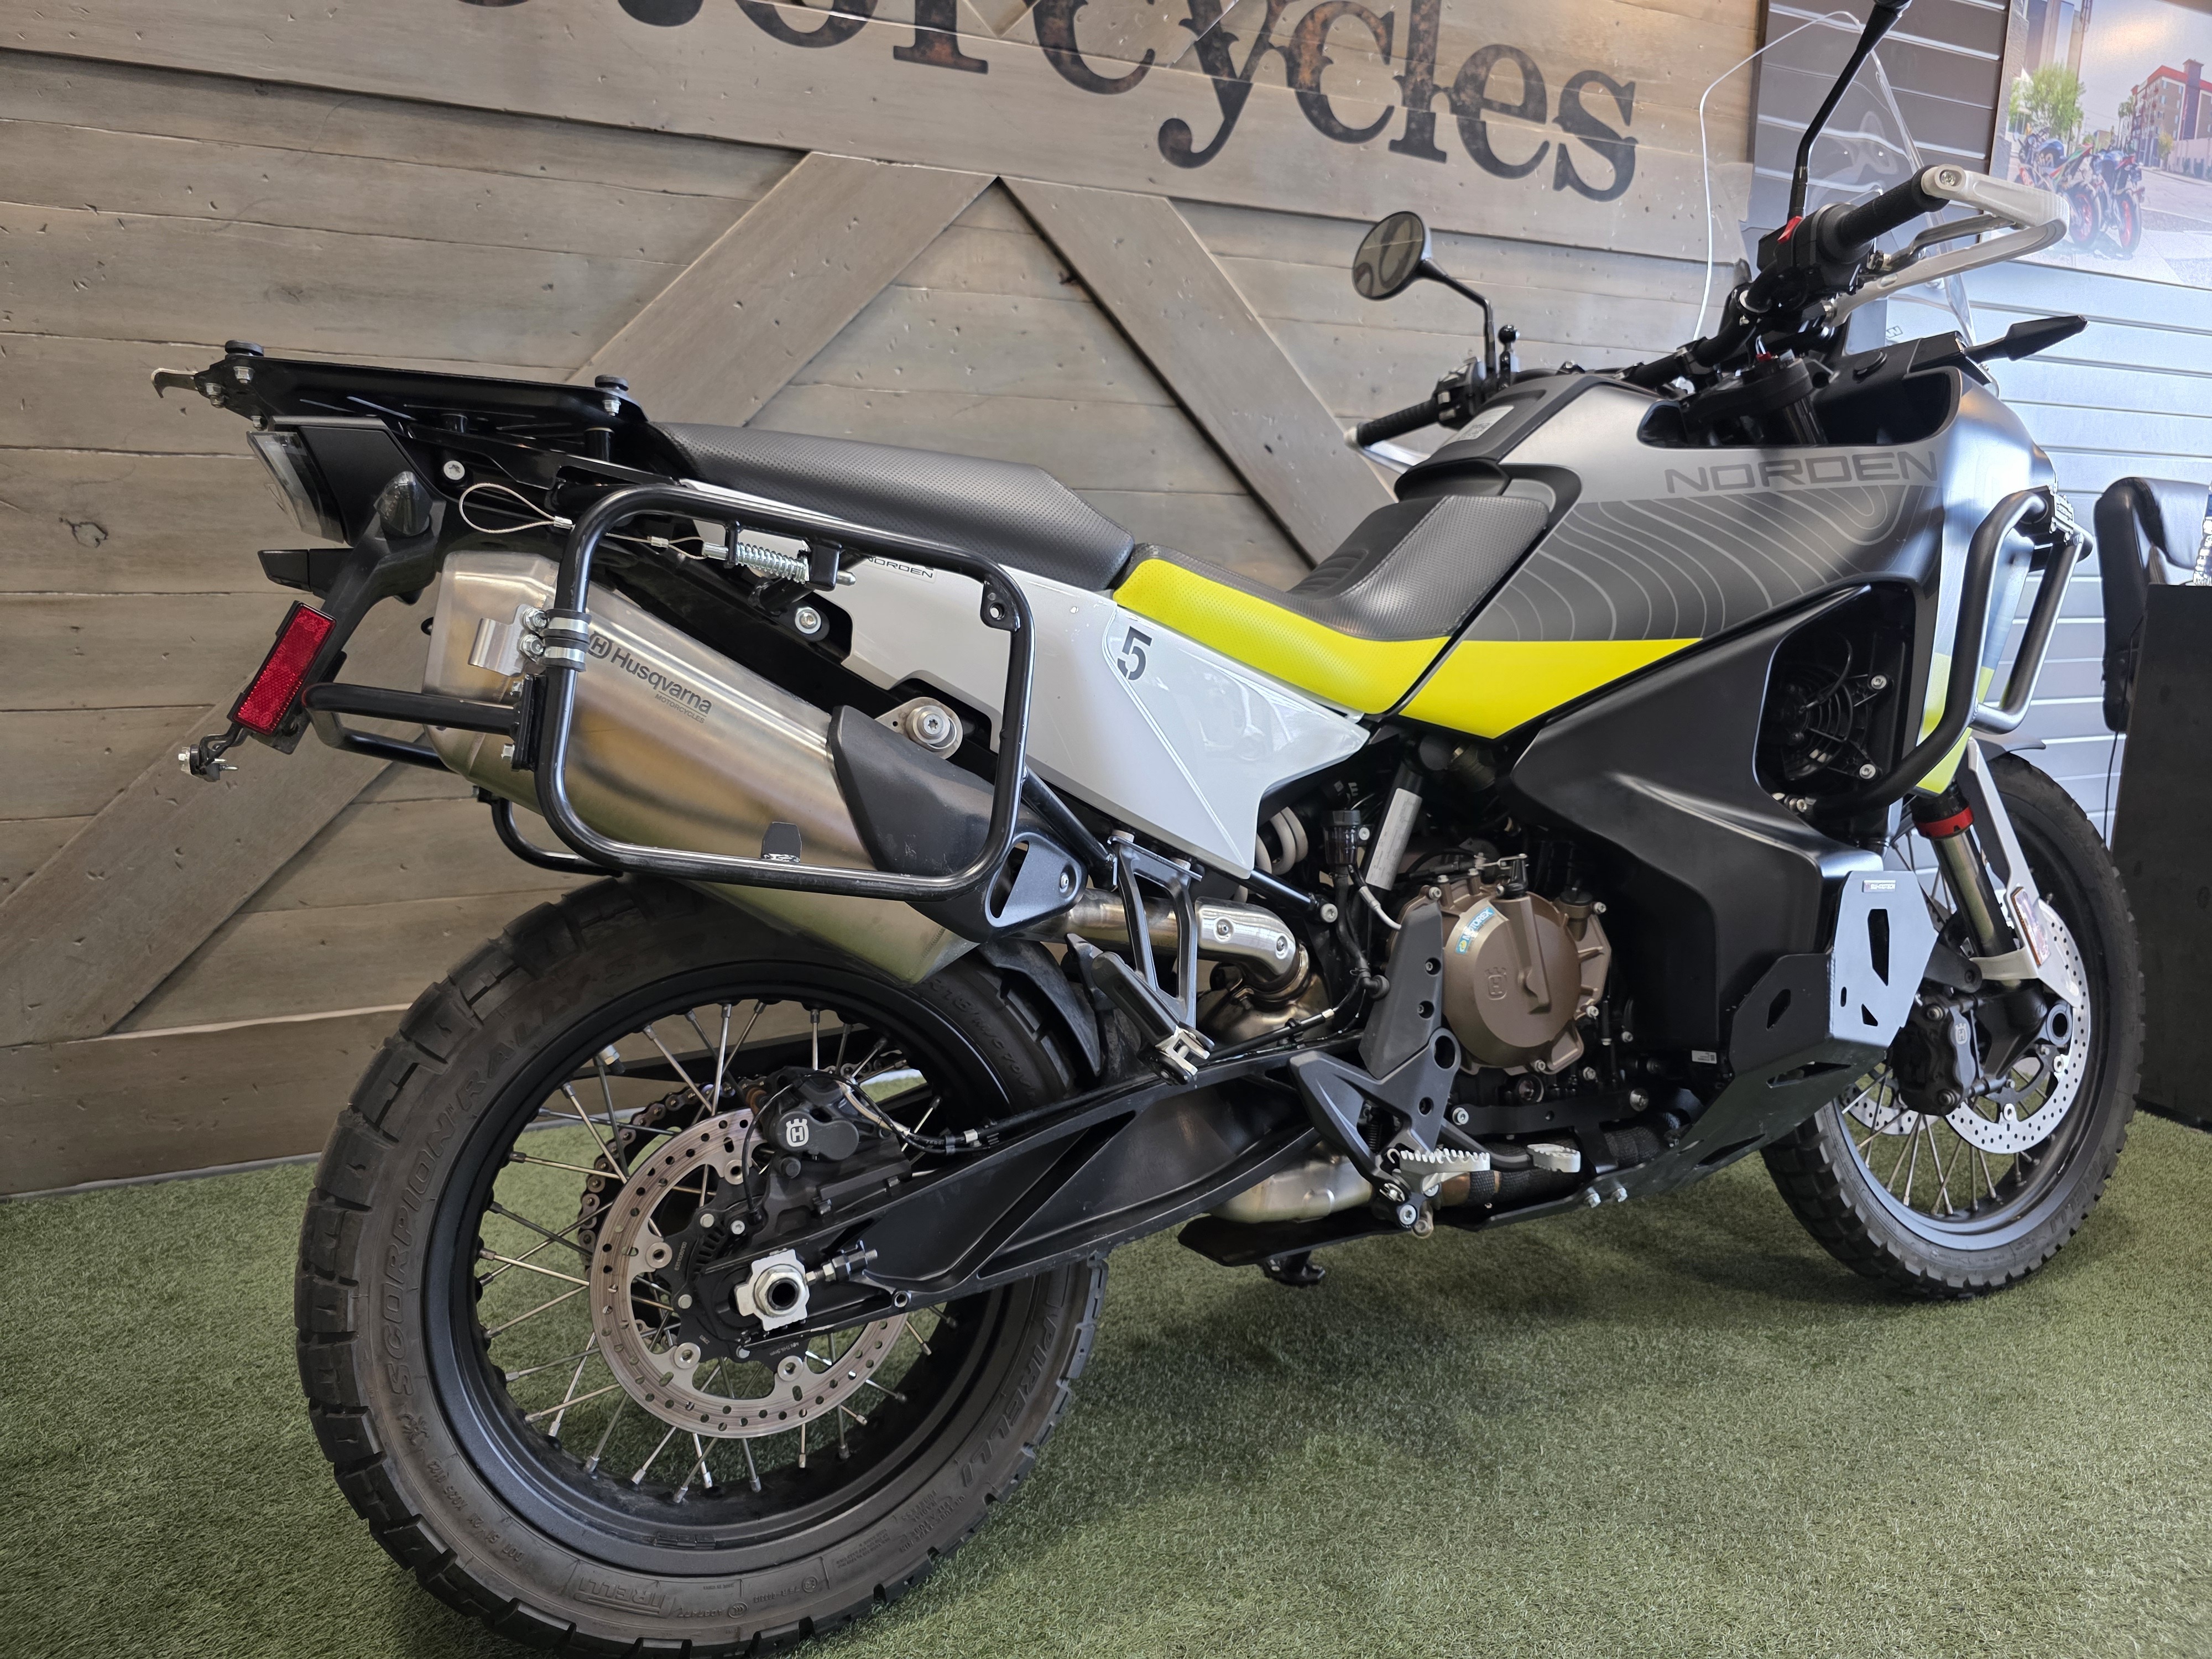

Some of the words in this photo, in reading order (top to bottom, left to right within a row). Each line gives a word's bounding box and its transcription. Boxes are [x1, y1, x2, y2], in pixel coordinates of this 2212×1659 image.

[1665, 451, 1938, 494] NORDEN
[611, 647, 713, 714] Husqvarna
[1117, 625, 1152, 681] 5
[654, 693, 705, 724] MOTORCYCLES
[380, 1113, 458, 1396] SCORPION
[455, 972, 591, 1112] RALLY
[961, 1314, 1057, 1488] PIRELLI
[573, 1577, 675, 1619] PIRELLI
